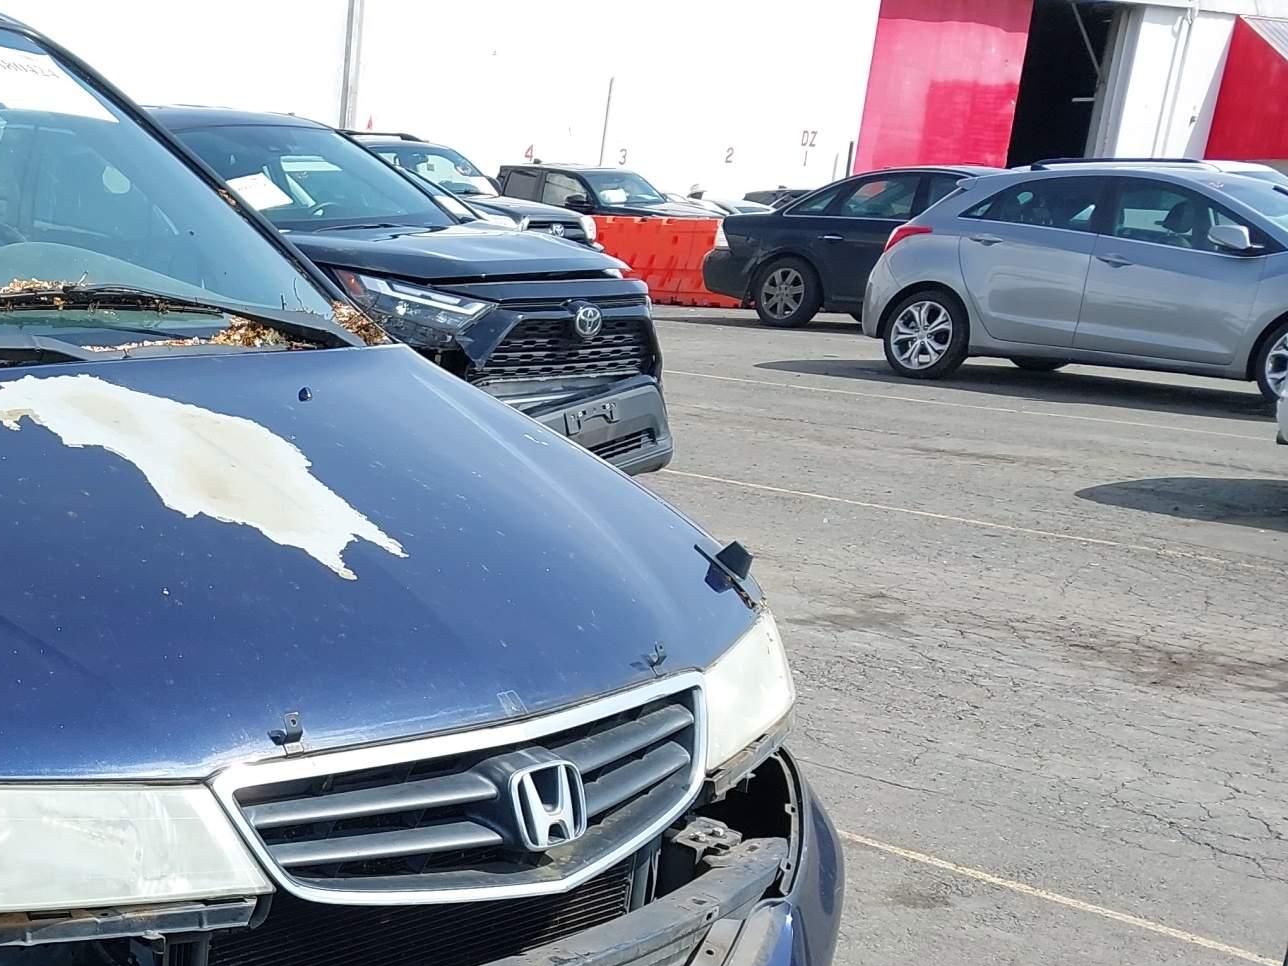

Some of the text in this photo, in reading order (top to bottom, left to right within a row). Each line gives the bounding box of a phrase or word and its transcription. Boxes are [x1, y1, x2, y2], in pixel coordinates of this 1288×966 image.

[524, 144, 533, 162] 4
[618, 148, 627, 165] 3
[725, 147, 734, 163] 2
